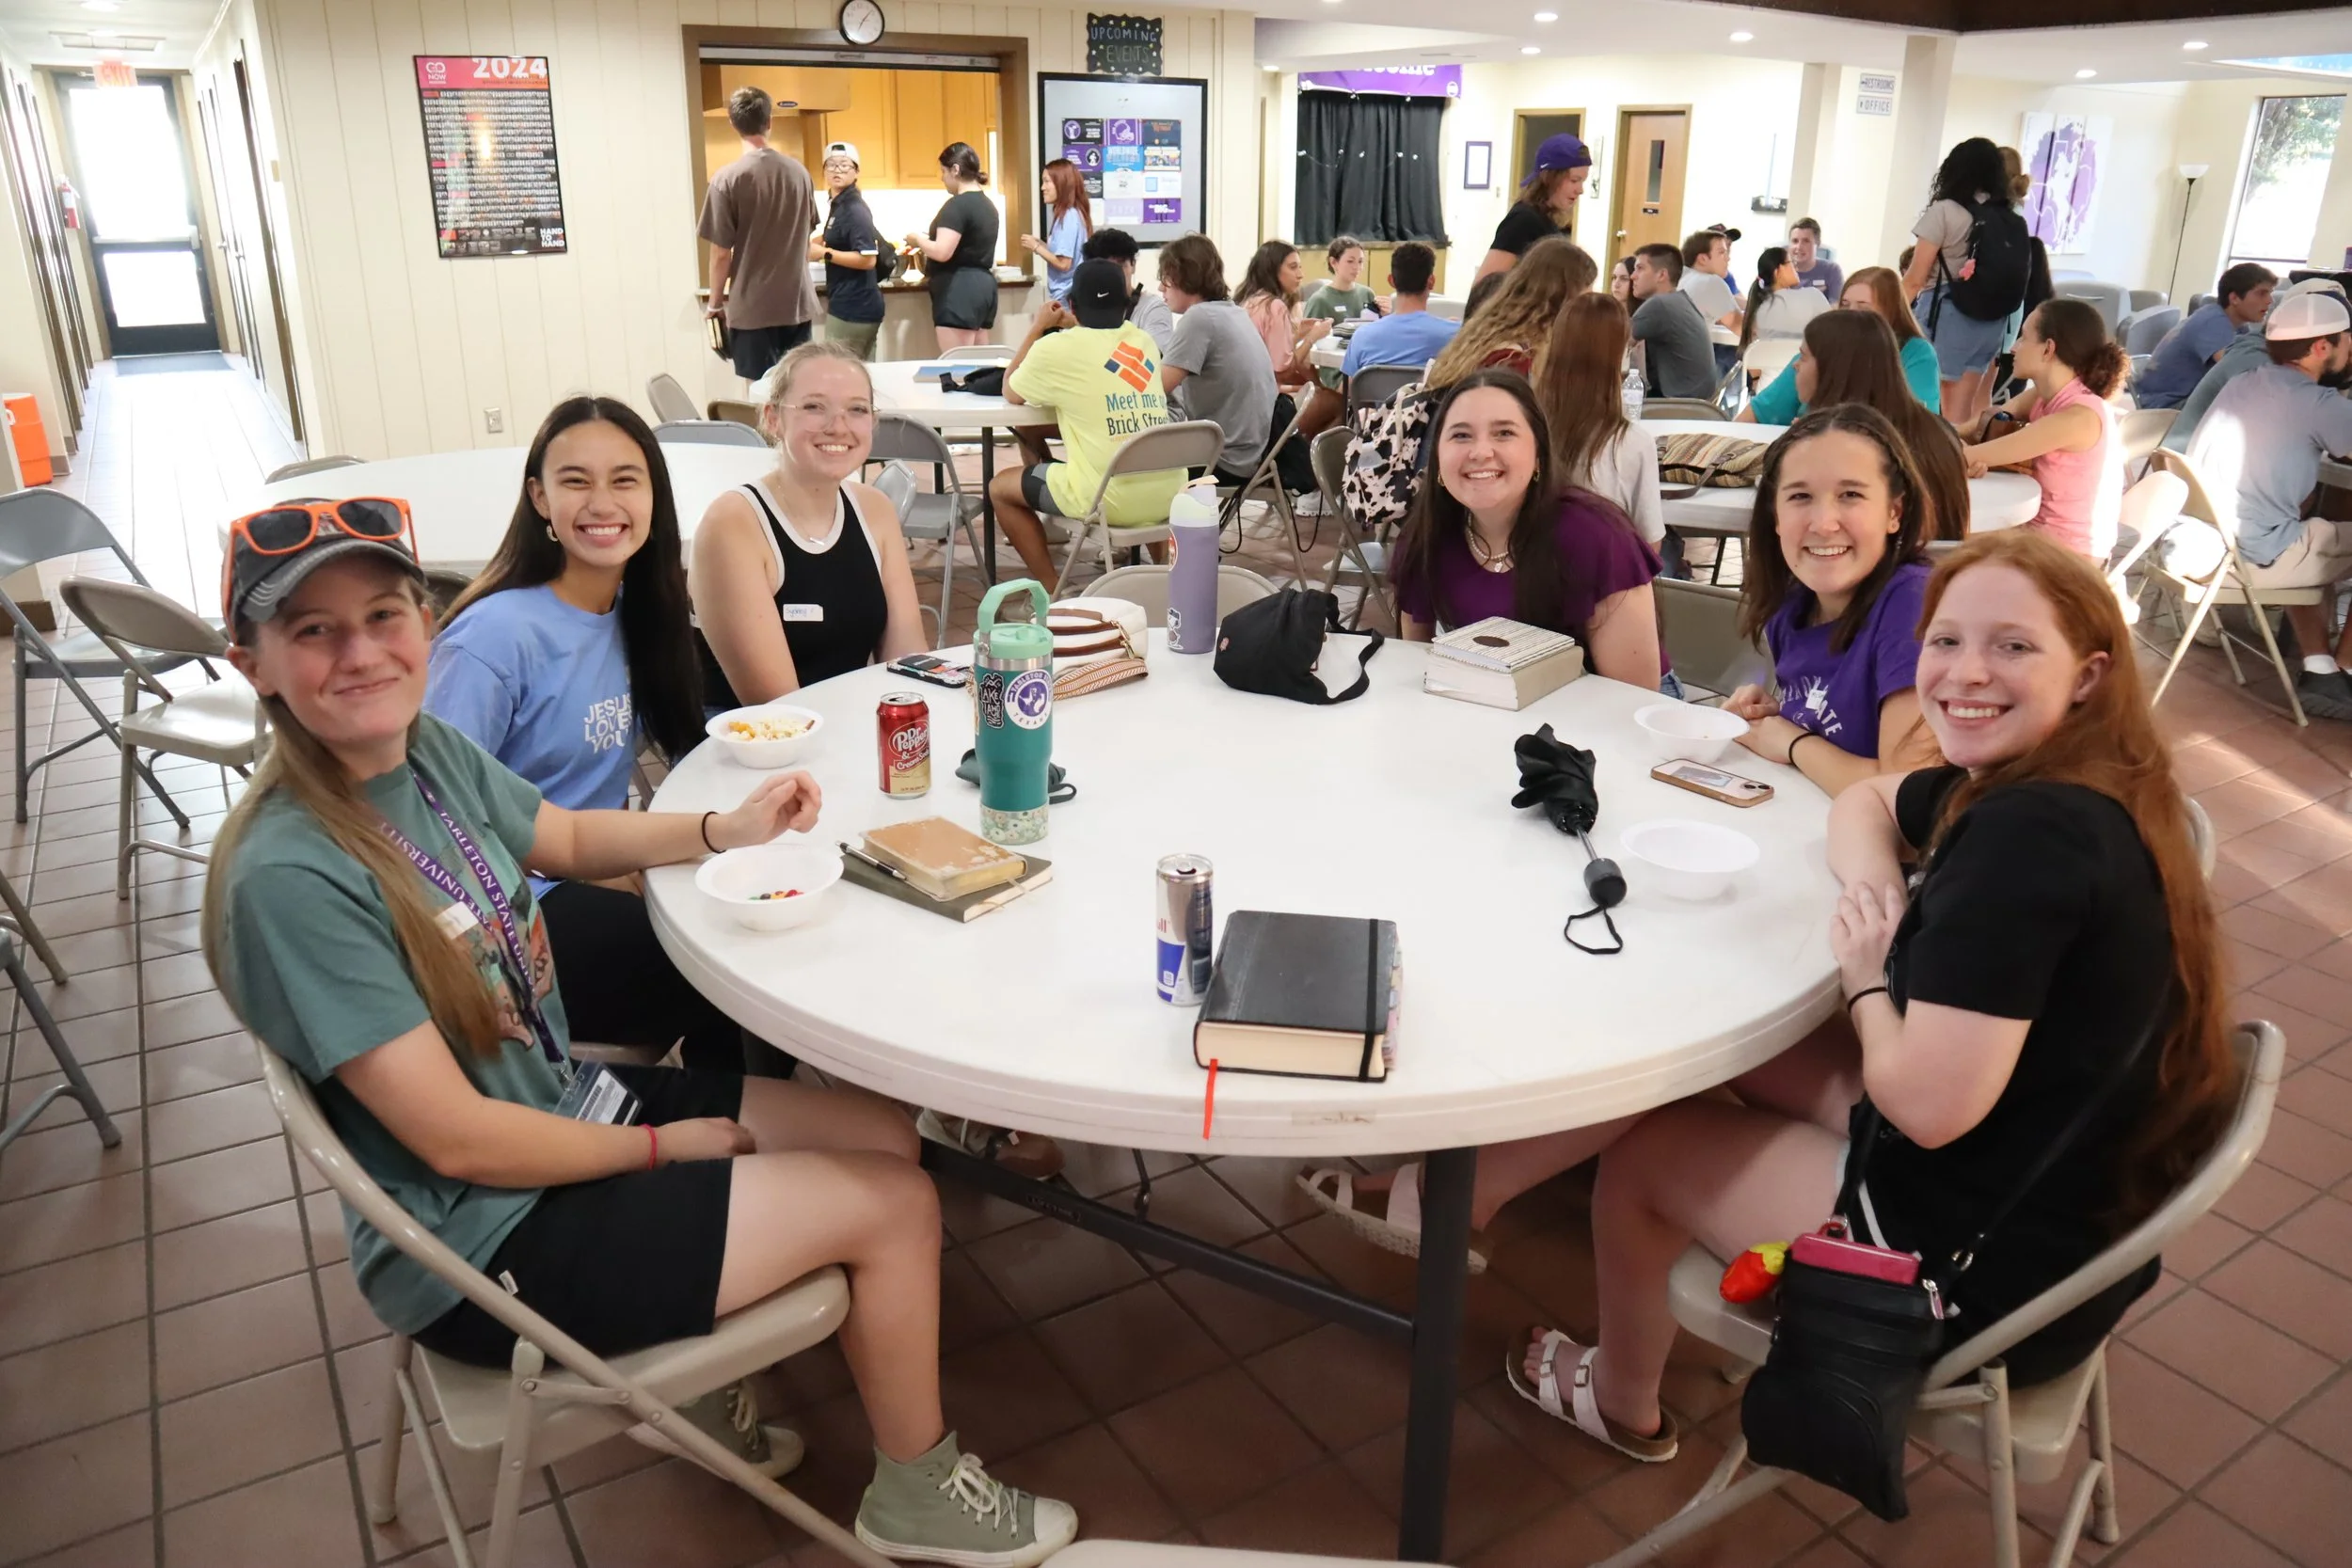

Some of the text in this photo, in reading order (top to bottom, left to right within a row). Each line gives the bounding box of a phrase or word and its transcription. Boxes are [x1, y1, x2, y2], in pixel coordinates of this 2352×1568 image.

[1090, 26, 1157, 43] UPCOMING
[1106, 45, 1150, 64] EVENTS
[101, 65, 131, 86] EXIT
[426, 62, 446, 73] GO
[472, 57, 547, 79] 2024
[1865, 100, 1890, 112] OFFICE
[1105, 391, 1138, 412] Meet
[1141, 393, 1158, 408] me
[1106, 411, 1141, 436] Brick
[893, 729, 928, 752] Pepper
[907, 727, 922, 739] Dr
[897, 757, 919, 770] Cream
[902, 751, 910, 760] &
[440, 810, 519, 941] TARLETON STATE
